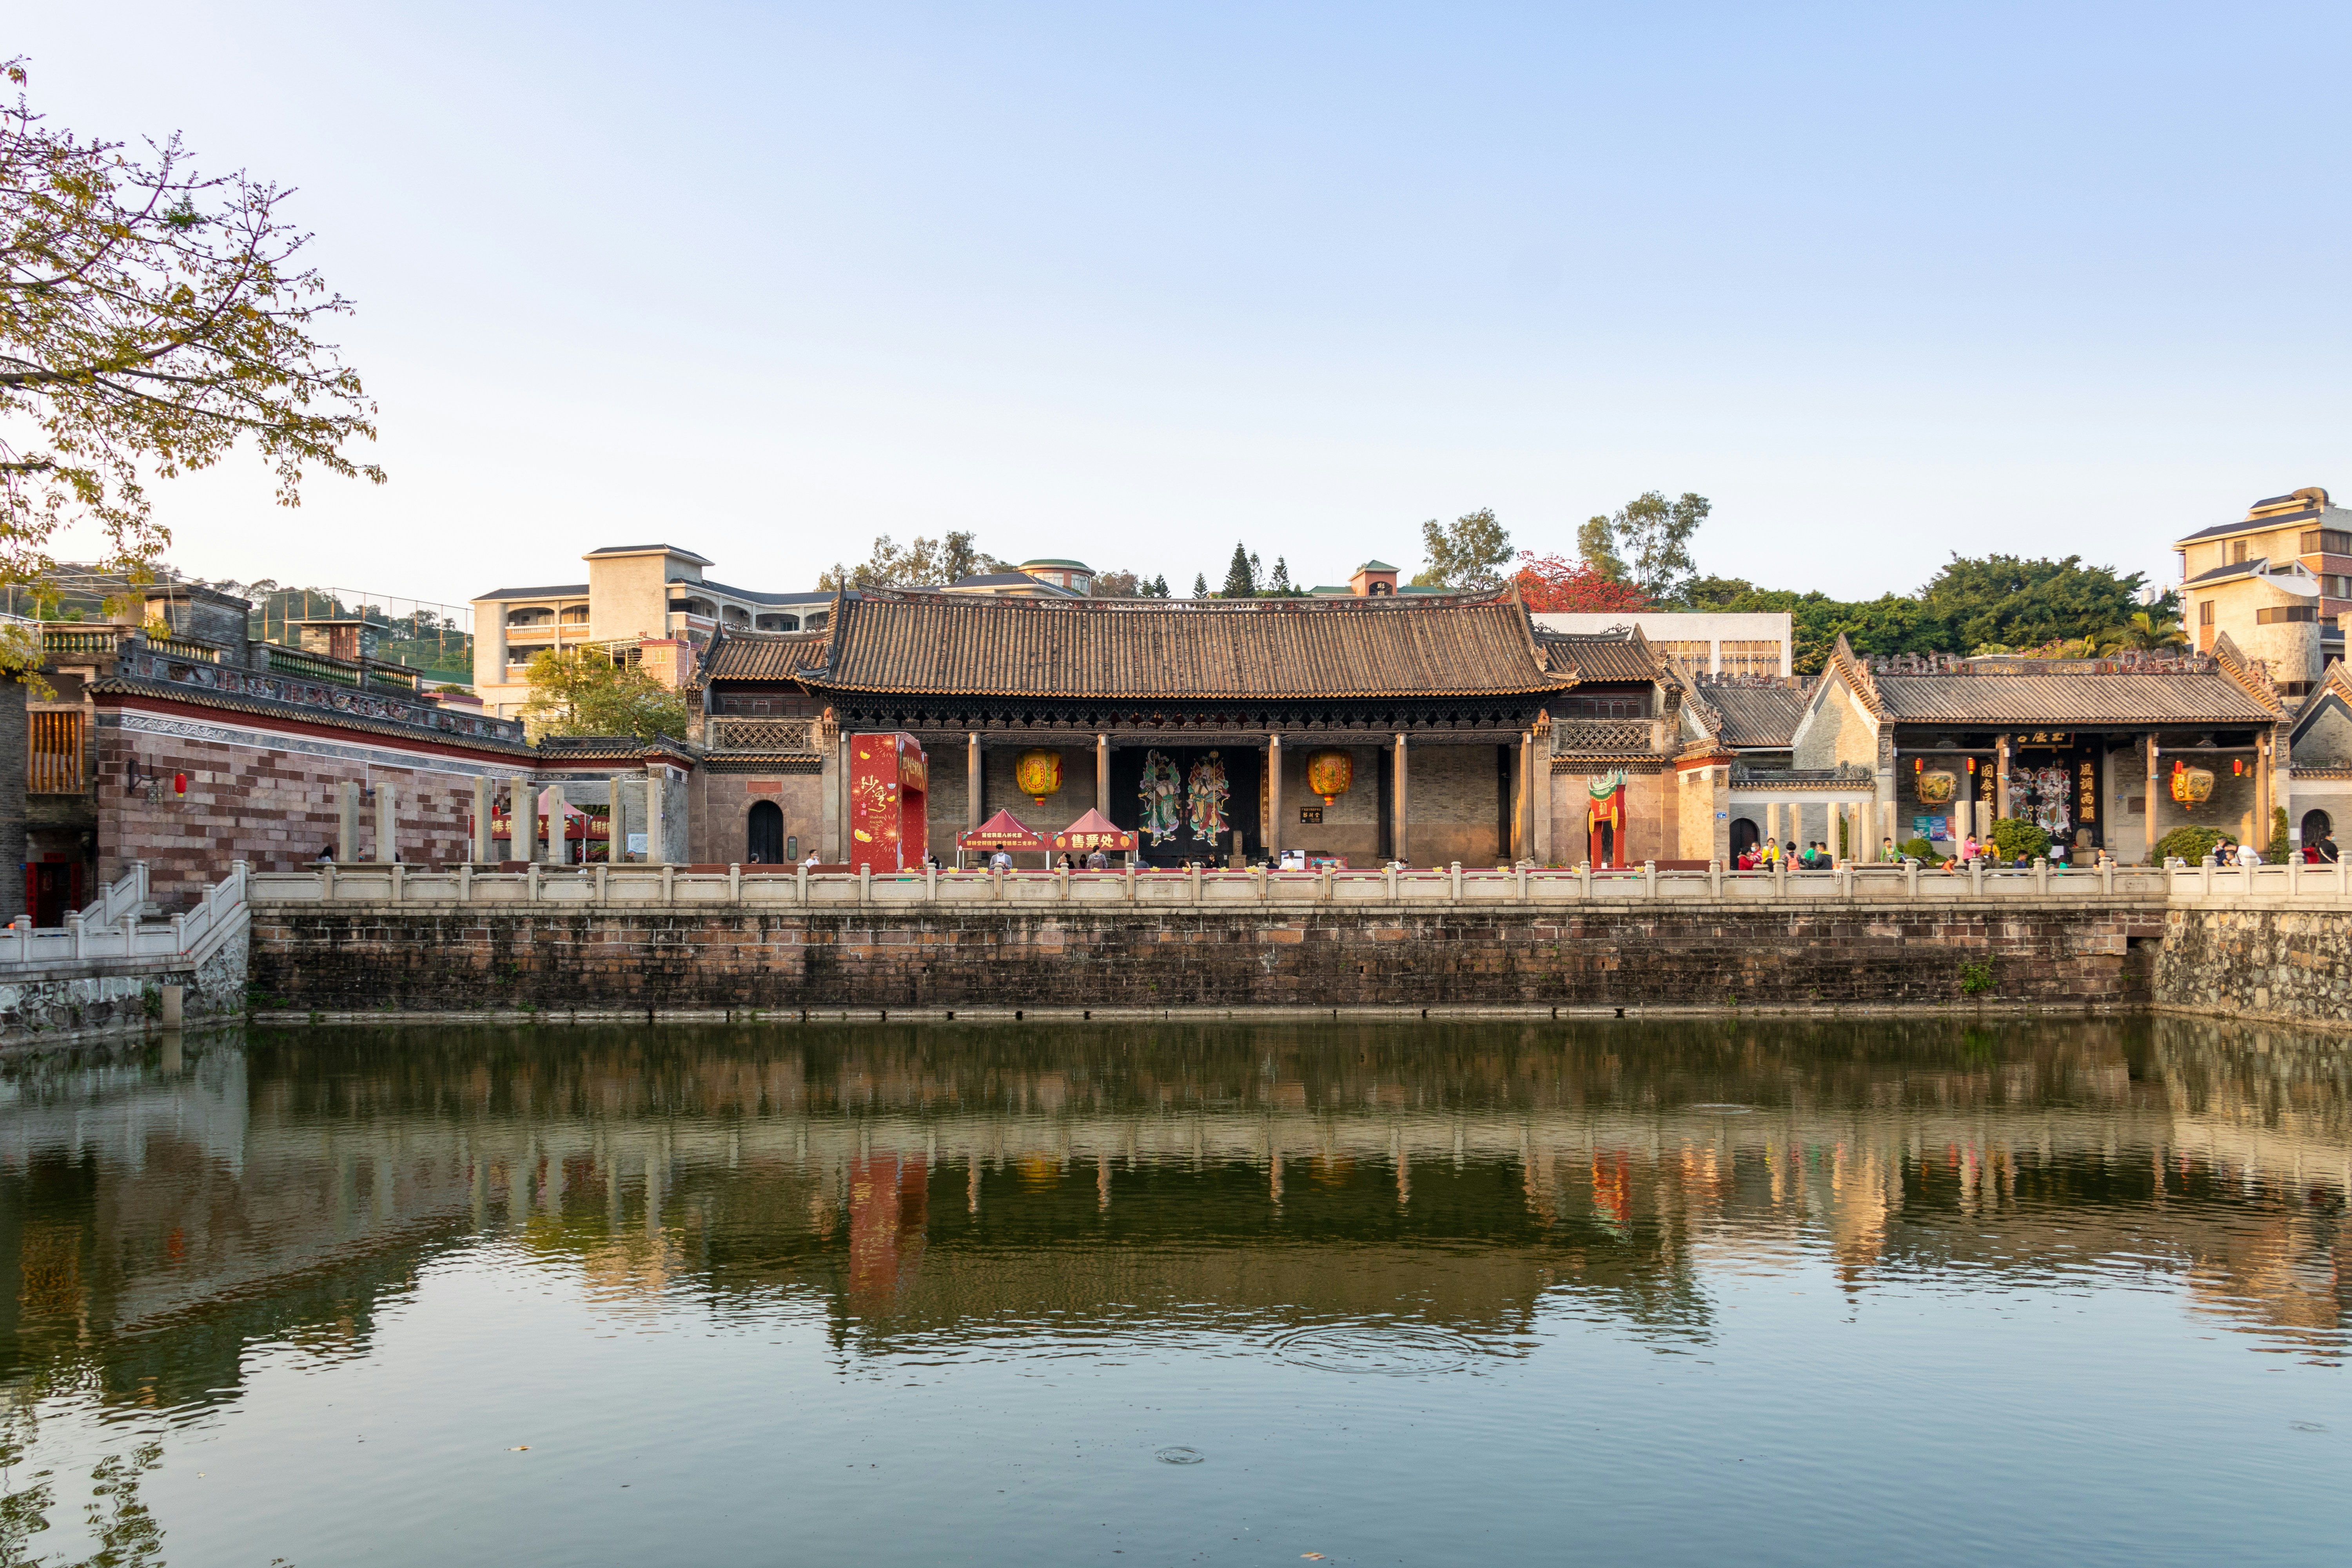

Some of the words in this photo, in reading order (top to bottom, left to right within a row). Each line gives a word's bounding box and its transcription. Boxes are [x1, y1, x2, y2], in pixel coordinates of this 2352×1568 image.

[2080, 764, 2094, 819] 風調雨順
[1071, 834, 1114, 849] 售票处
